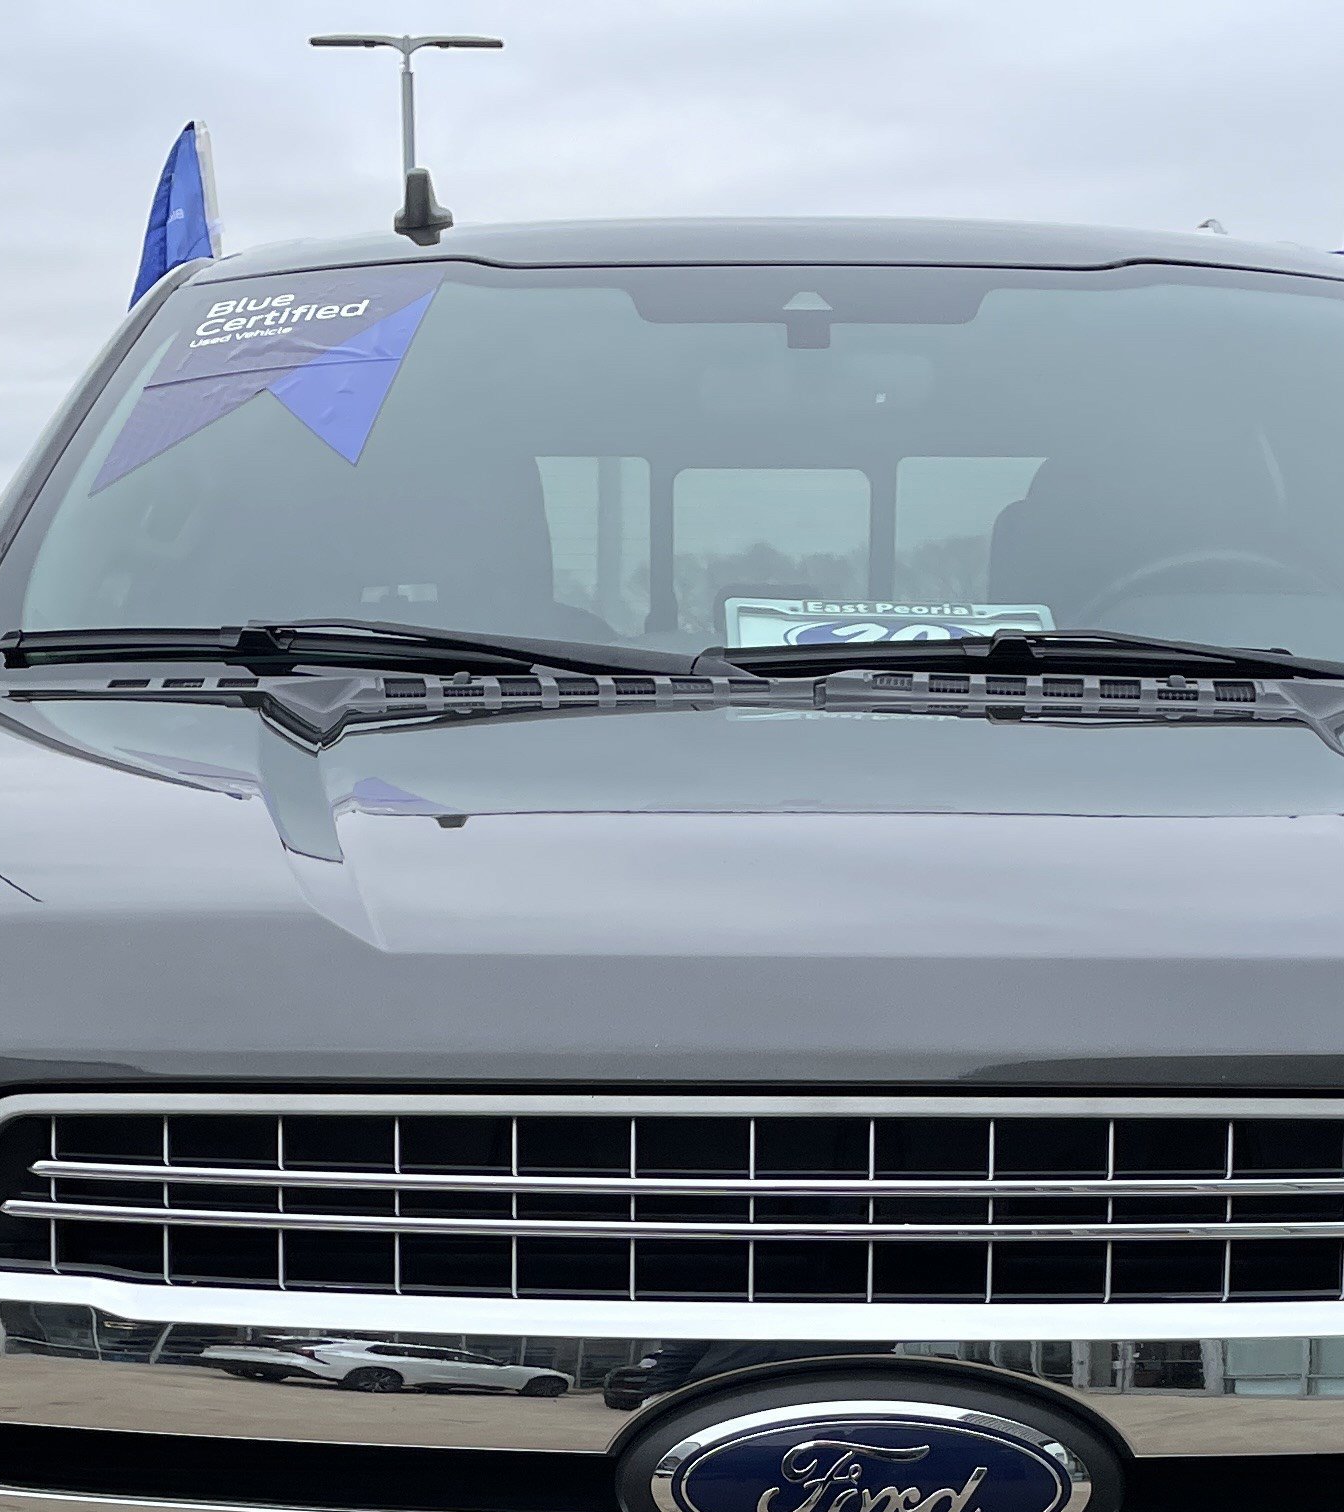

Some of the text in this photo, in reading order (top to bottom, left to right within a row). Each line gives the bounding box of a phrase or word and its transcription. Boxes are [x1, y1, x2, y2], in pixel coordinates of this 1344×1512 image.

[195, 299, 370, 336] Certified
[206, 293, 295, 319] Blue
[189, 326, 293, 348] Used Vehicle
[807, 601, 969, 615] East Peoria
